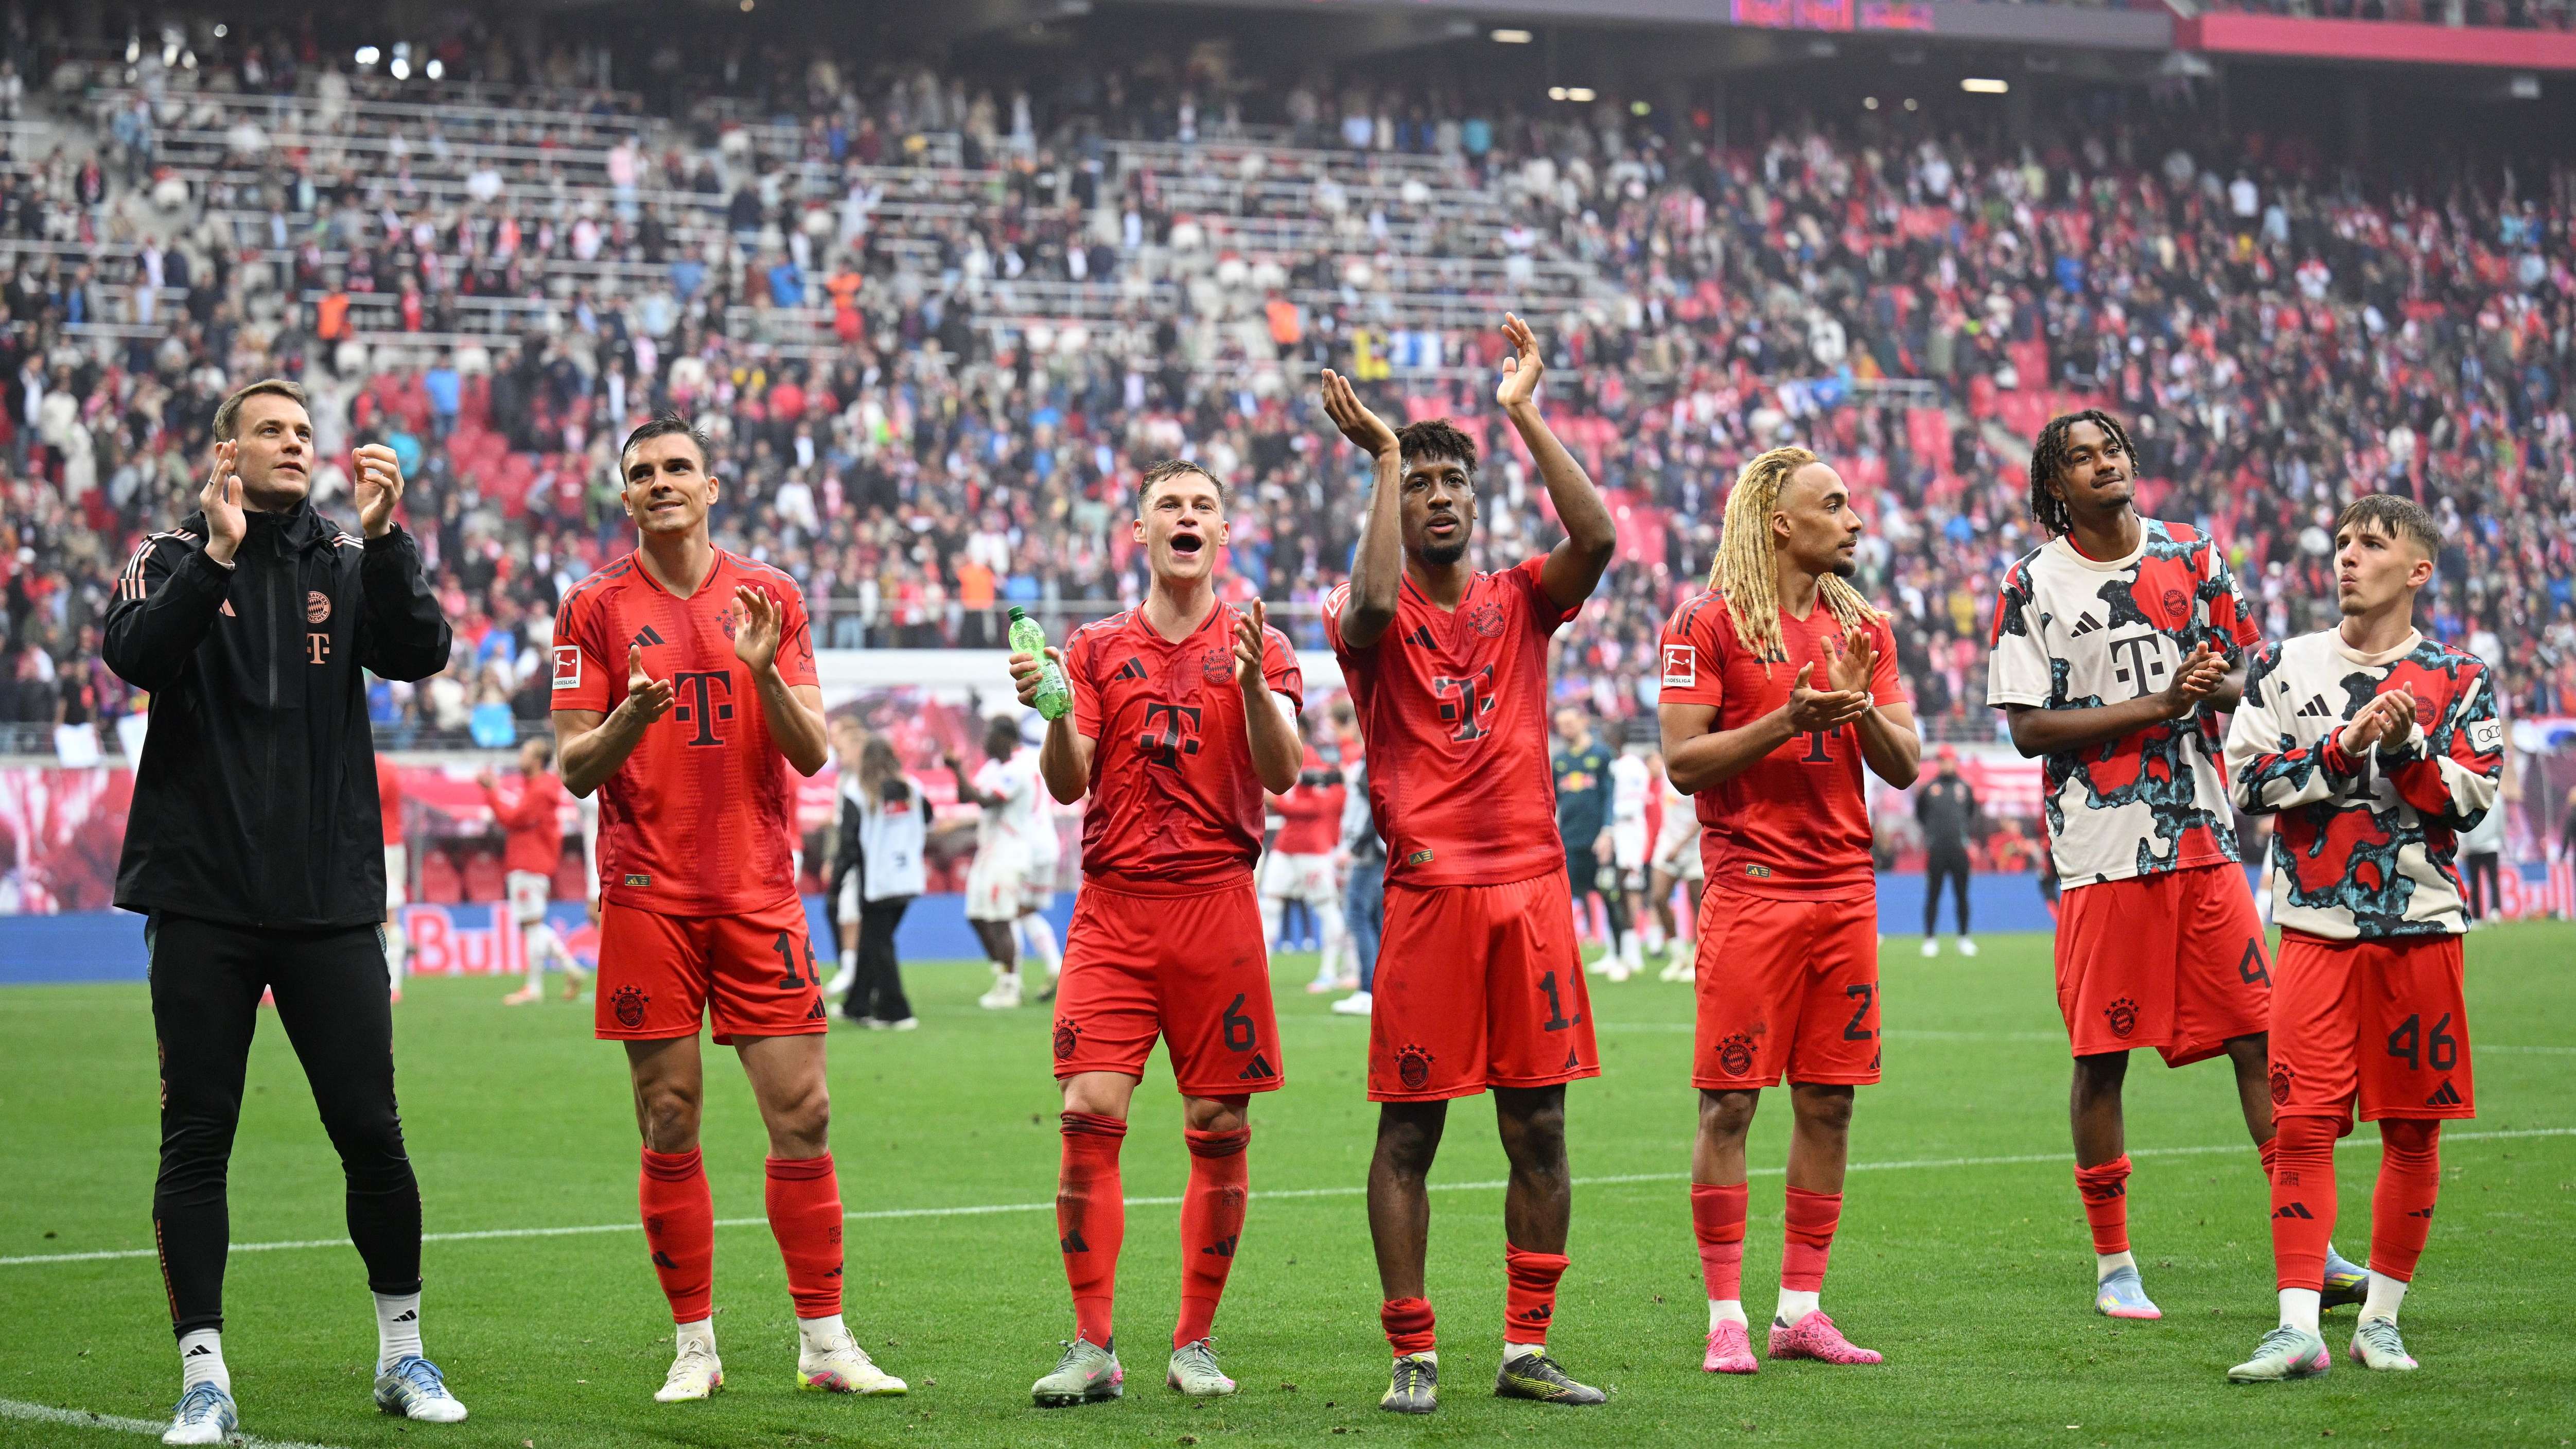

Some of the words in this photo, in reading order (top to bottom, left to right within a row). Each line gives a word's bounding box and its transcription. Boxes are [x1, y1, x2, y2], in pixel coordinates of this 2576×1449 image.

[308, 610, 327, 621] NCHEN
[309, 593, 328, 605] BAYERN
[307, 633, 330, 664] T
[2110, 633, 2165, 699] T
[674, 670, 733, 746] T
[1434, 665, 1496, 742] T
[1141, 703, 1201, 775] T
[1222, 992, 1256, 1053] 6
[2388, 1012, 2456, 1071] 46
